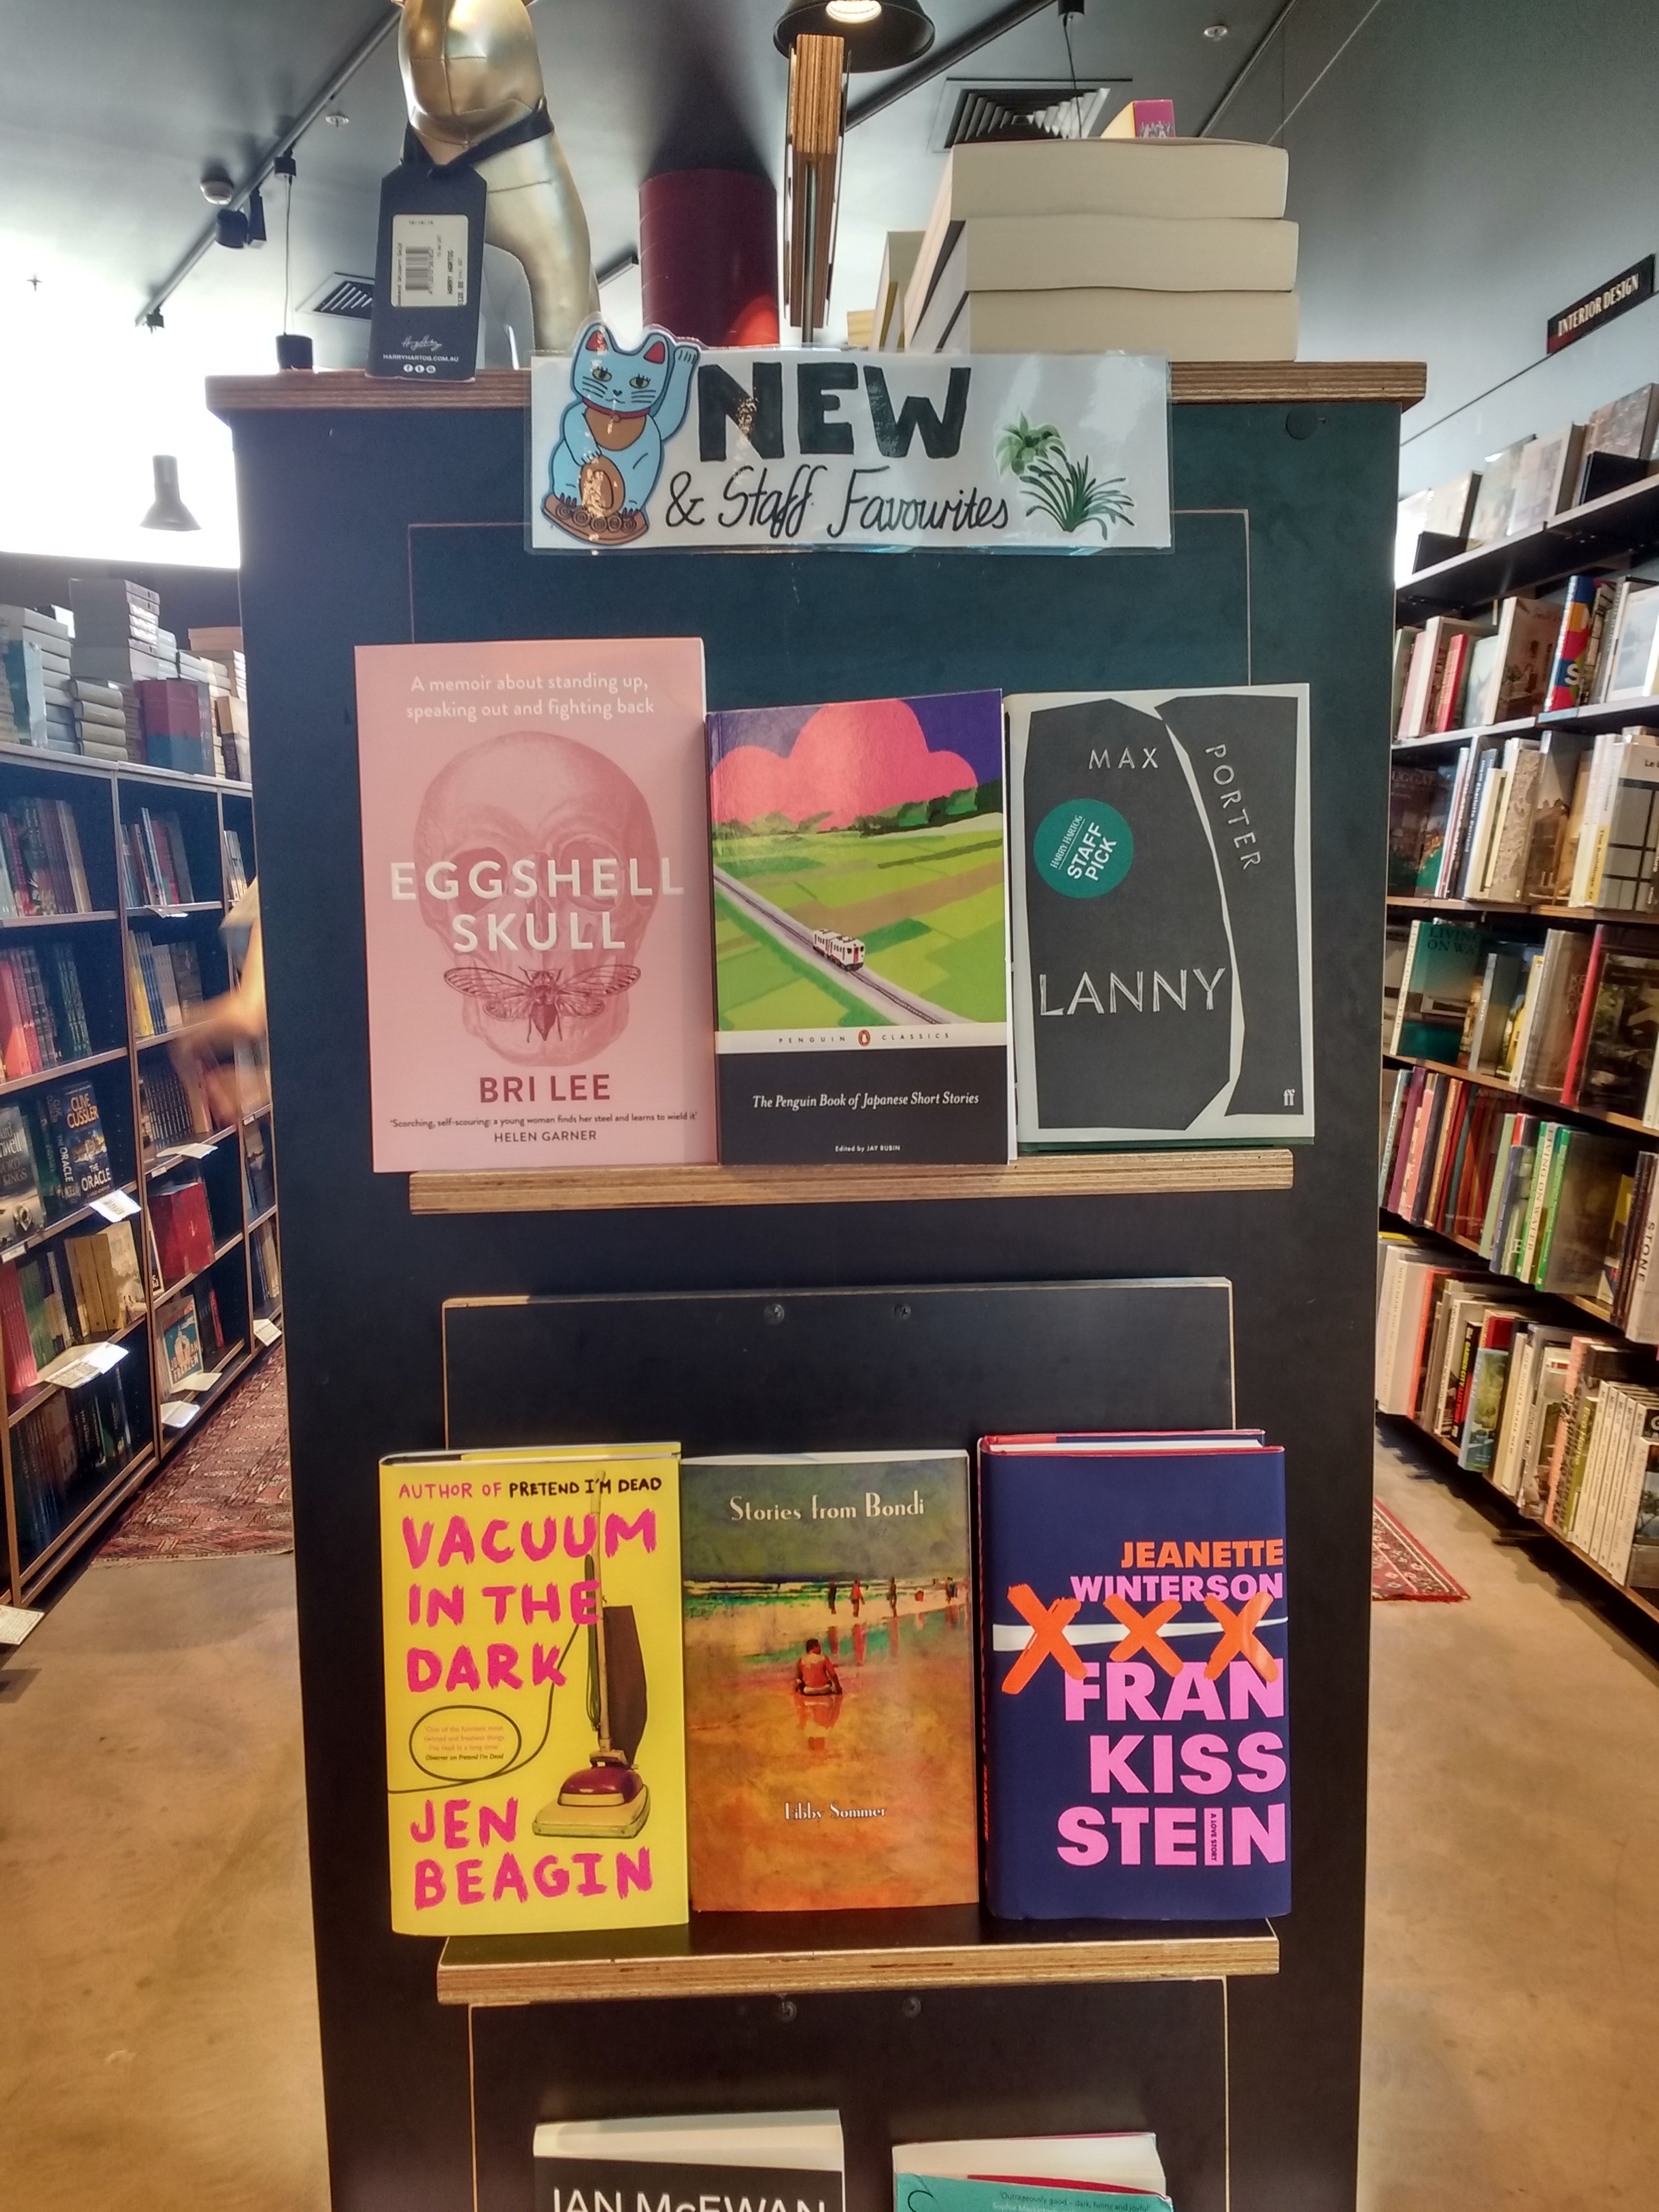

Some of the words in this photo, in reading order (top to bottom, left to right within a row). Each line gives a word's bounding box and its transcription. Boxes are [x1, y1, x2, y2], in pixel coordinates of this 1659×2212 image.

[1557, 296, 1602, 336] INTERIOR
[1603, 273, 1639, 309] DESIGN
[383, 354, 459, 363] HARRYHARTOG.COM.AU
[697, 361, 971, 462] NEW
[665, 471, 705, 526] &
[718, 464, 827, 538] Staff
[827, 465, 1011, 538] Favourites
[410, 676, 425, 692] A
[429, 675, 492, 692] memoir
[497, 673, 543, 691] about
[548, 672, 617, 694] standing
[622, 677, 649, 694] up,
[406, 702, 477, 723] speaking
[482, 703, 508, 716] out
[514, 699, 542, 716] and
[548, 698, 612, 721] fighting
[617, 697, 655, 714] back
[1088, 746, 1159, 770] MAX
[1204, 742, 1262, 871] PORTER
[1050, 843, 1068, 868] HARRY
[1062, 815, 1083, 845] HARTOG
[1067, 822, 1101, 879] STAFF
[1085, 836, 1117, 881] PICK
[390, 858, 685, 902] EGGSHELL
[453, 911, 627, 953] SKULL
[1038, 967, 1226, 1016] LANNY
[778, 1035, 846, 1044] PENGUIN
[882, 1032, 950, 1041] CLASSICS
[71, 1093, 91, 1112] CLIVE
[480, 1075, 535, 1103] BRI
[550, 1074, 610, 1101] LEE
[753, 1094, 773, 1109] The
[775, 1094, 817, 1111] Penguin
[819, 1093, 847, 1107] Book
[848, 1092, 861, 1110] of
[860, 1092, 908, 1110] Japanese
[910, 1091, 940, 1105] Short
[942, 1090, 979, 1105] Stories
[67, 1105, 99, 1128] CUSSLER
[500, 1119, 525, 1129] young
[557, 1115, 577, 1124] finds
[579, 1115, 592, 1123] her
[594, 1114, 613, 1122] steel
[615, 1113, 630, 1122] and
[631, 1113, 655, 1122] learns
[667, 1112, 687, 1120] wield
[494, 1131, 537, 1143] HELEN
[541, 1129, 597, 1142] GARNER
[857, 1145, 865, 1154] by
[1539, 1128, 1553, 1177] LIVING
[59, 1147, 74, 1183] ORACLE
[81, 1168, 112, 1191] ORACLE
[89, 1163, 100, 1173] THE
[1536, 1182, 1545, 1202] ON
[1527, 1205, 1541, 1251] WATER
[1638, 1221, 1655, 1283] STONE
[399, 1482, 473, 1499] AUTHOR
[482, 1481, 502, 1497] OF
[509, 1481, 580, 1498] PRETEND
[584, 1478, 612, 1494] I'M
[617, 1477, 662, 1493] DEAD
[730, 1495, 802, 1521] Stories
[811, 1494, 857, 1519] from
[865, 1490, 924, 1518] Bondi
[401, 1508, 657, 1570] VACUUM
[1121, 1539, 1284, 1569] JEANETTE
[408, 1583, 464, 1628] IN
[482, 1579, 601, 1626] THE
[1070, 1572, 1283, 1603] WINTERSON
[406, 1642, 567, 1693] DARK
[1064, 1658, 1284, 1721] FRAN
[1090, 1731, 1287, 1795] KISS
[410, 1796, 518, 1850] JEN
[784, 1802, 824, 1823] Libby
[830, 1800, 886, 1819] Sommer
[1057, 1803, 1286, 1866] STEIN
[414, 1846, 653, 1911] BEAGIN
[554, 2187, 622, 2212] IAN
[1049, 2197, 1068, 2206] good
[1093, 2200, 1114, 2210] funny
